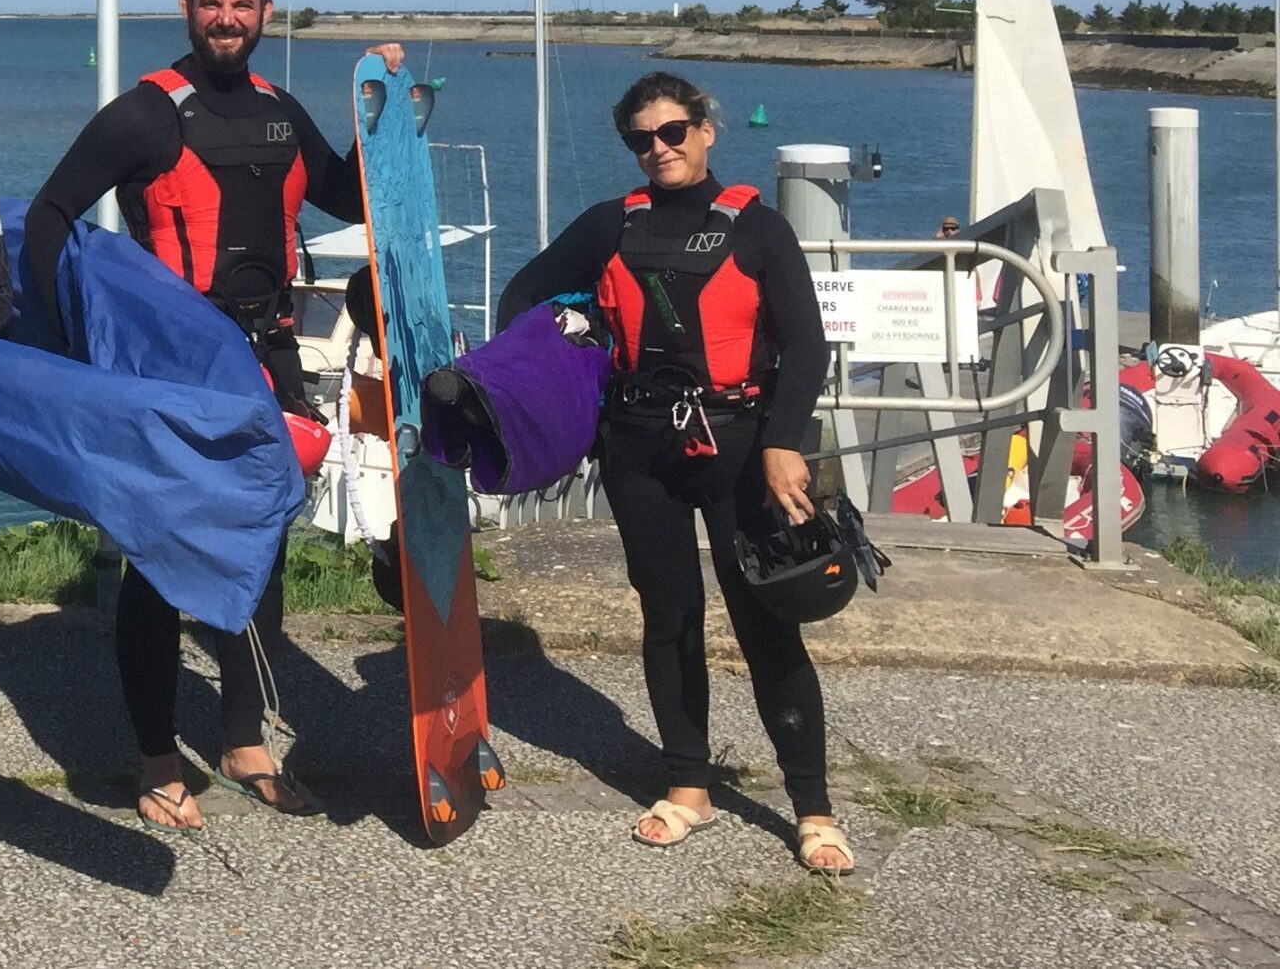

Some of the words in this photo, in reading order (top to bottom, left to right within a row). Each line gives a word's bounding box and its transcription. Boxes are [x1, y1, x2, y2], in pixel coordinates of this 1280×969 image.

[813, 281, 854, 292] SERVE
[818, 301, 837, 311] RS
[823, 321, 857, 332] RDITE
